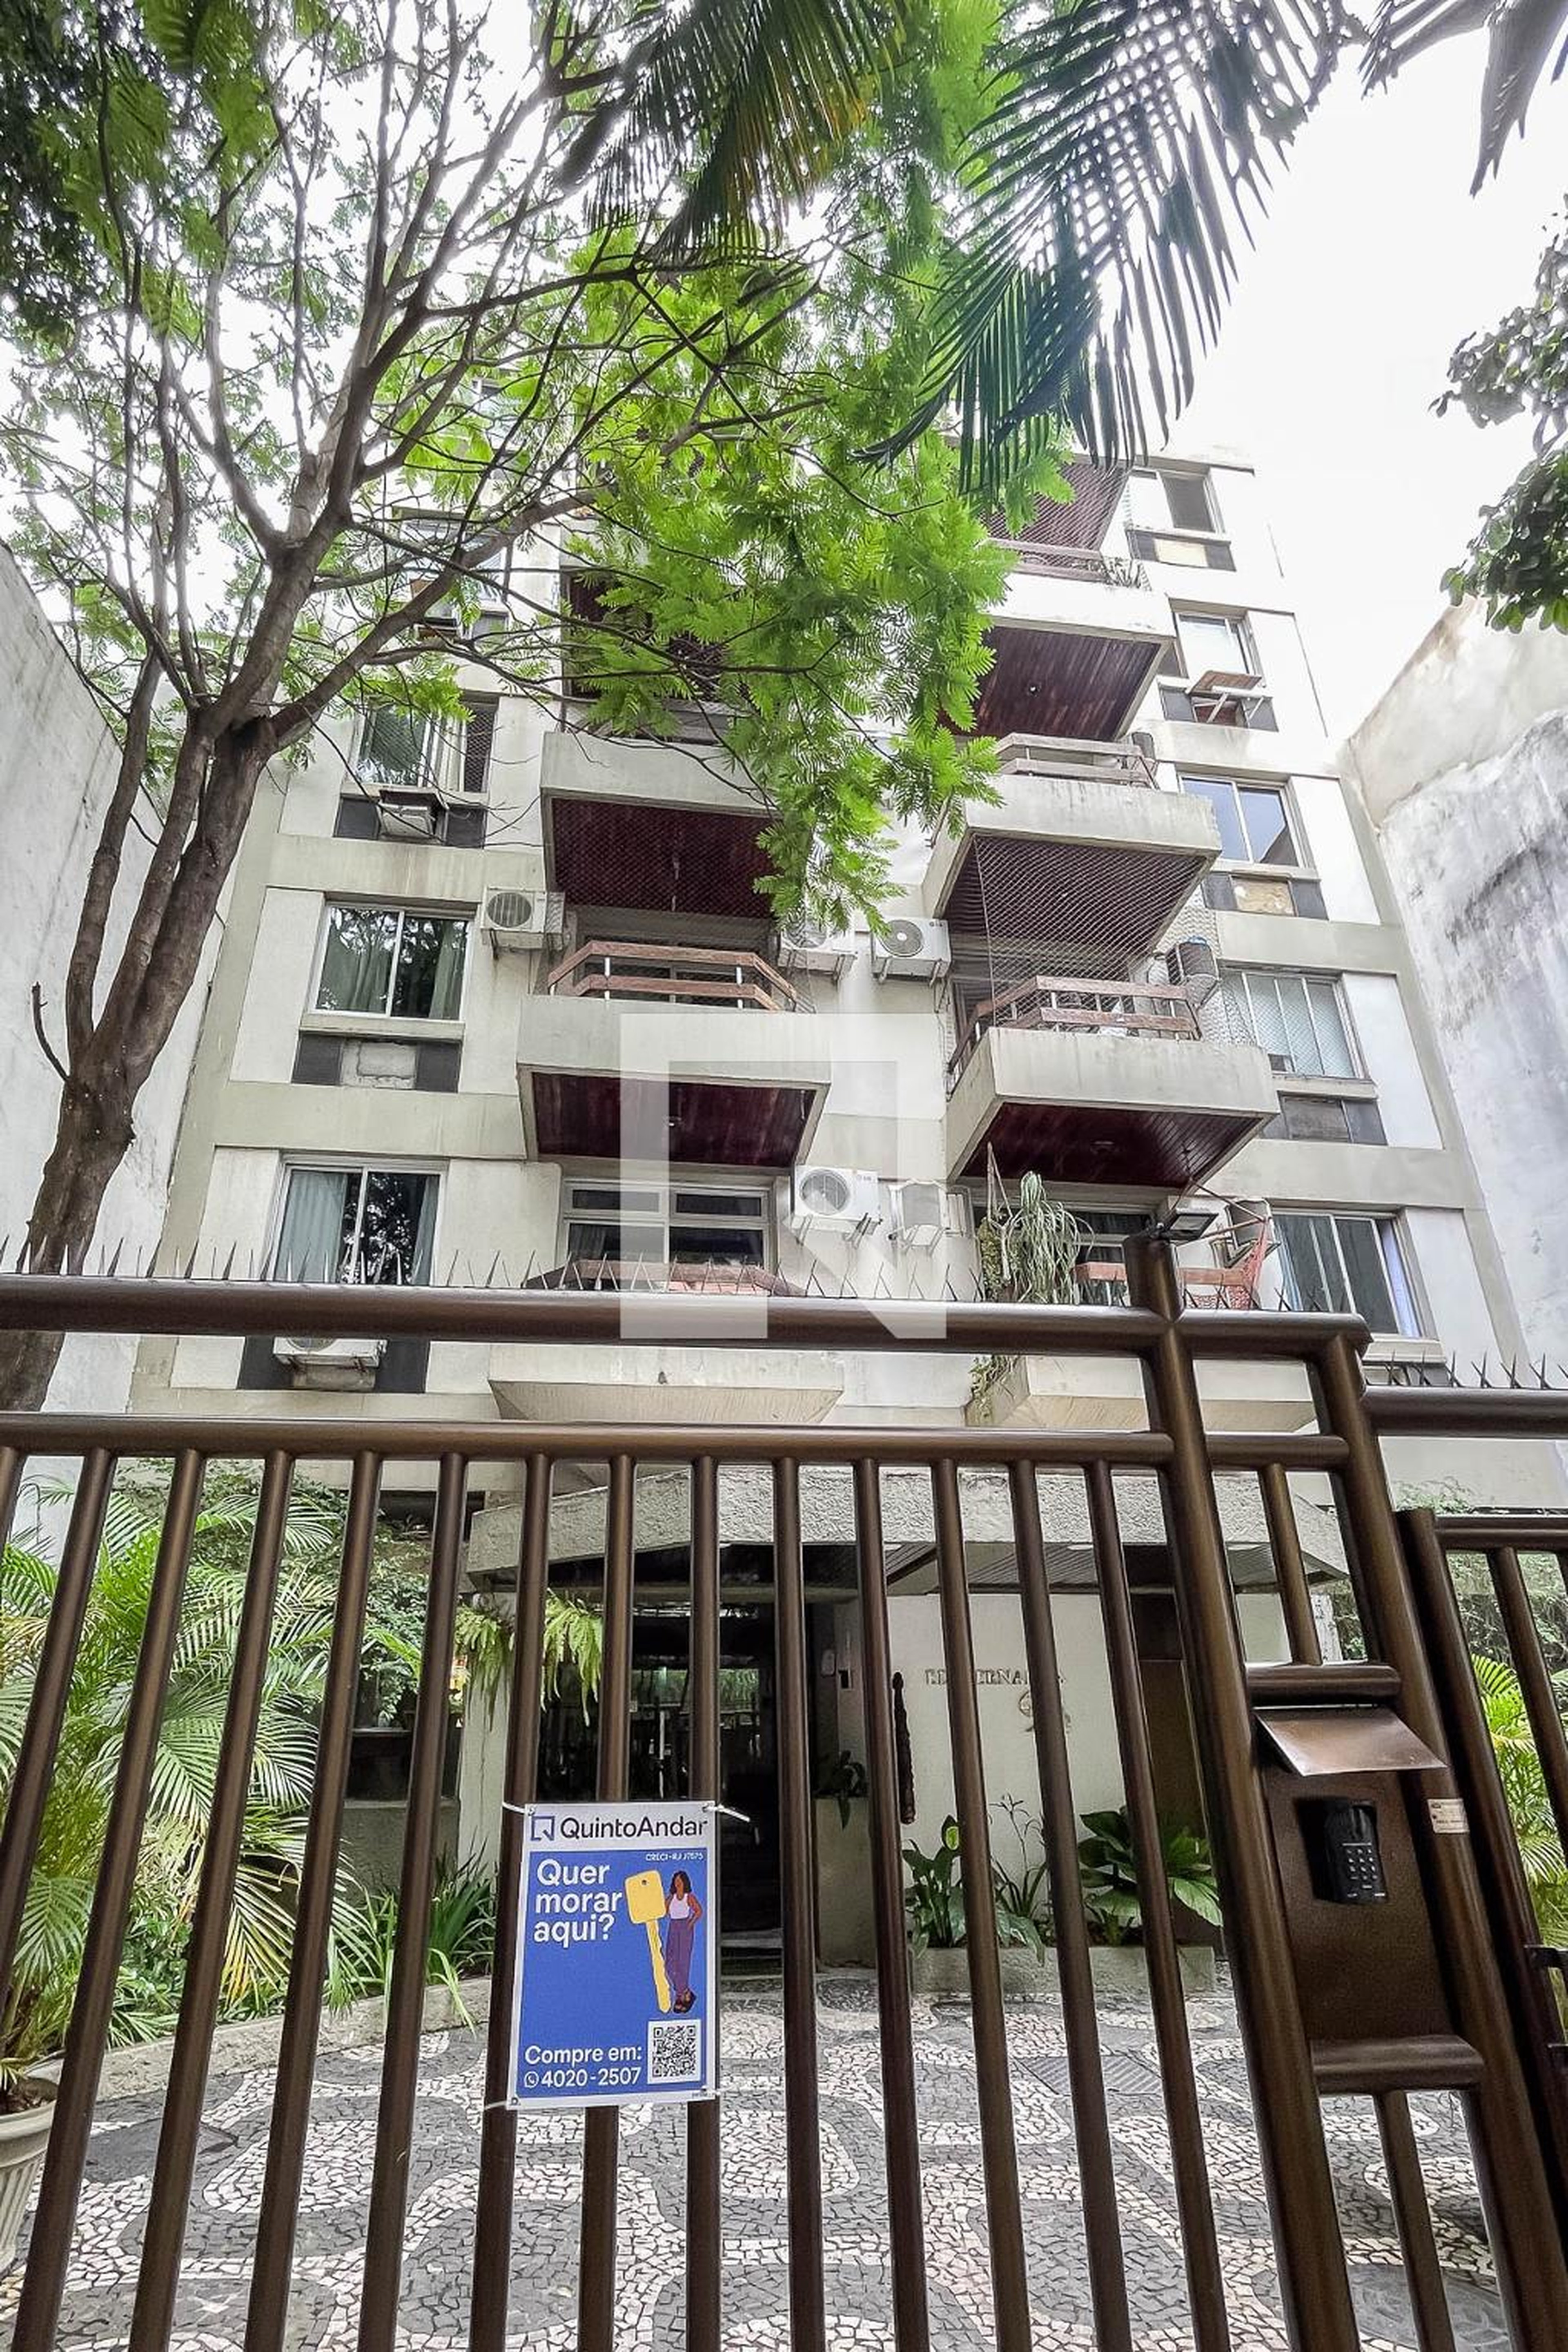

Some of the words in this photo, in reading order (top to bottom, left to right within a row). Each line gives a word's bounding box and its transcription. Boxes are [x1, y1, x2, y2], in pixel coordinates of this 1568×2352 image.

[560, 1816, 708, 1839] QuintoAndar
[537, 1859, 610, 1886] Quer
[536, 1892, 622, 1913] morar
[534, 1913, 615, 1948] aqui?
[525, 2045, 604, 2068] Compre
[608, 2046, 641, 2061] em:
